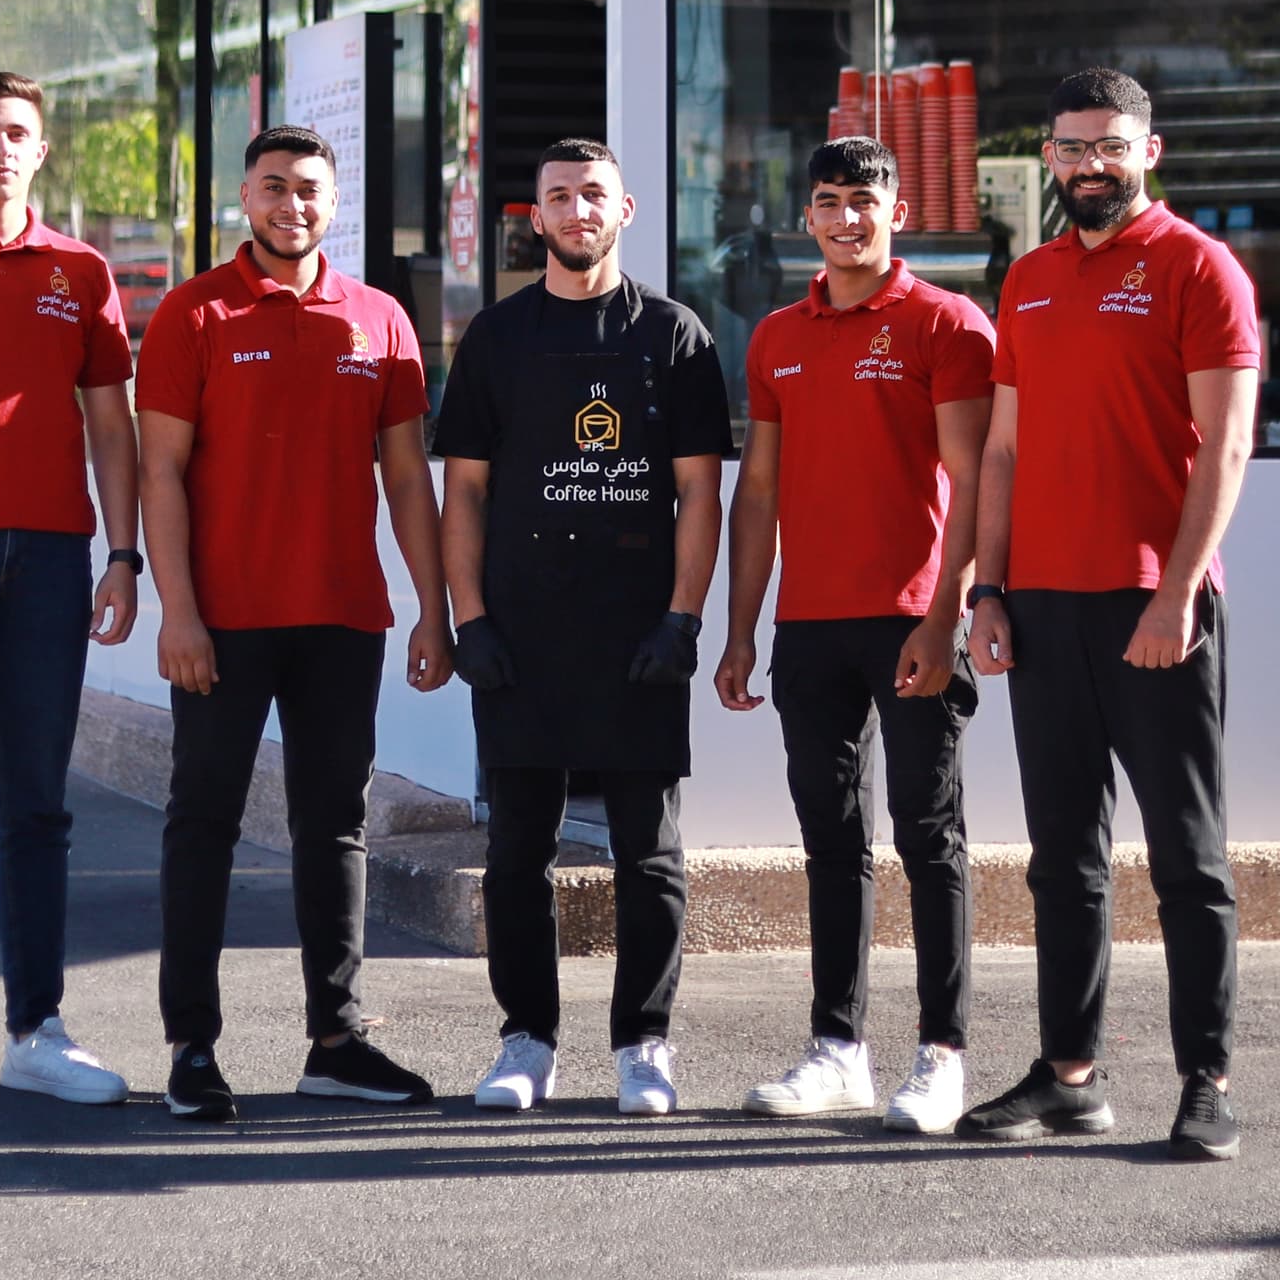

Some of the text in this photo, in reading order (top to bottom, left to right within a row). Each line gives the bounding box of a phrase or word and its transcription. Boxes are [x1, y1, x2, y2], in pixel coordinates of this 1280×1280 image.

[1099, 303, 1149, 316] Coffee House
[233, 350, 270, 363] Baraa
[773, 363, 801, 379] Ahmad
[854, 370, 903, 380] Coffee House
[592, 442, 605, 452] PS
[543, 457, 650, 482] كوفي هاوس
[543, 485, 650, 501] Coffee House
